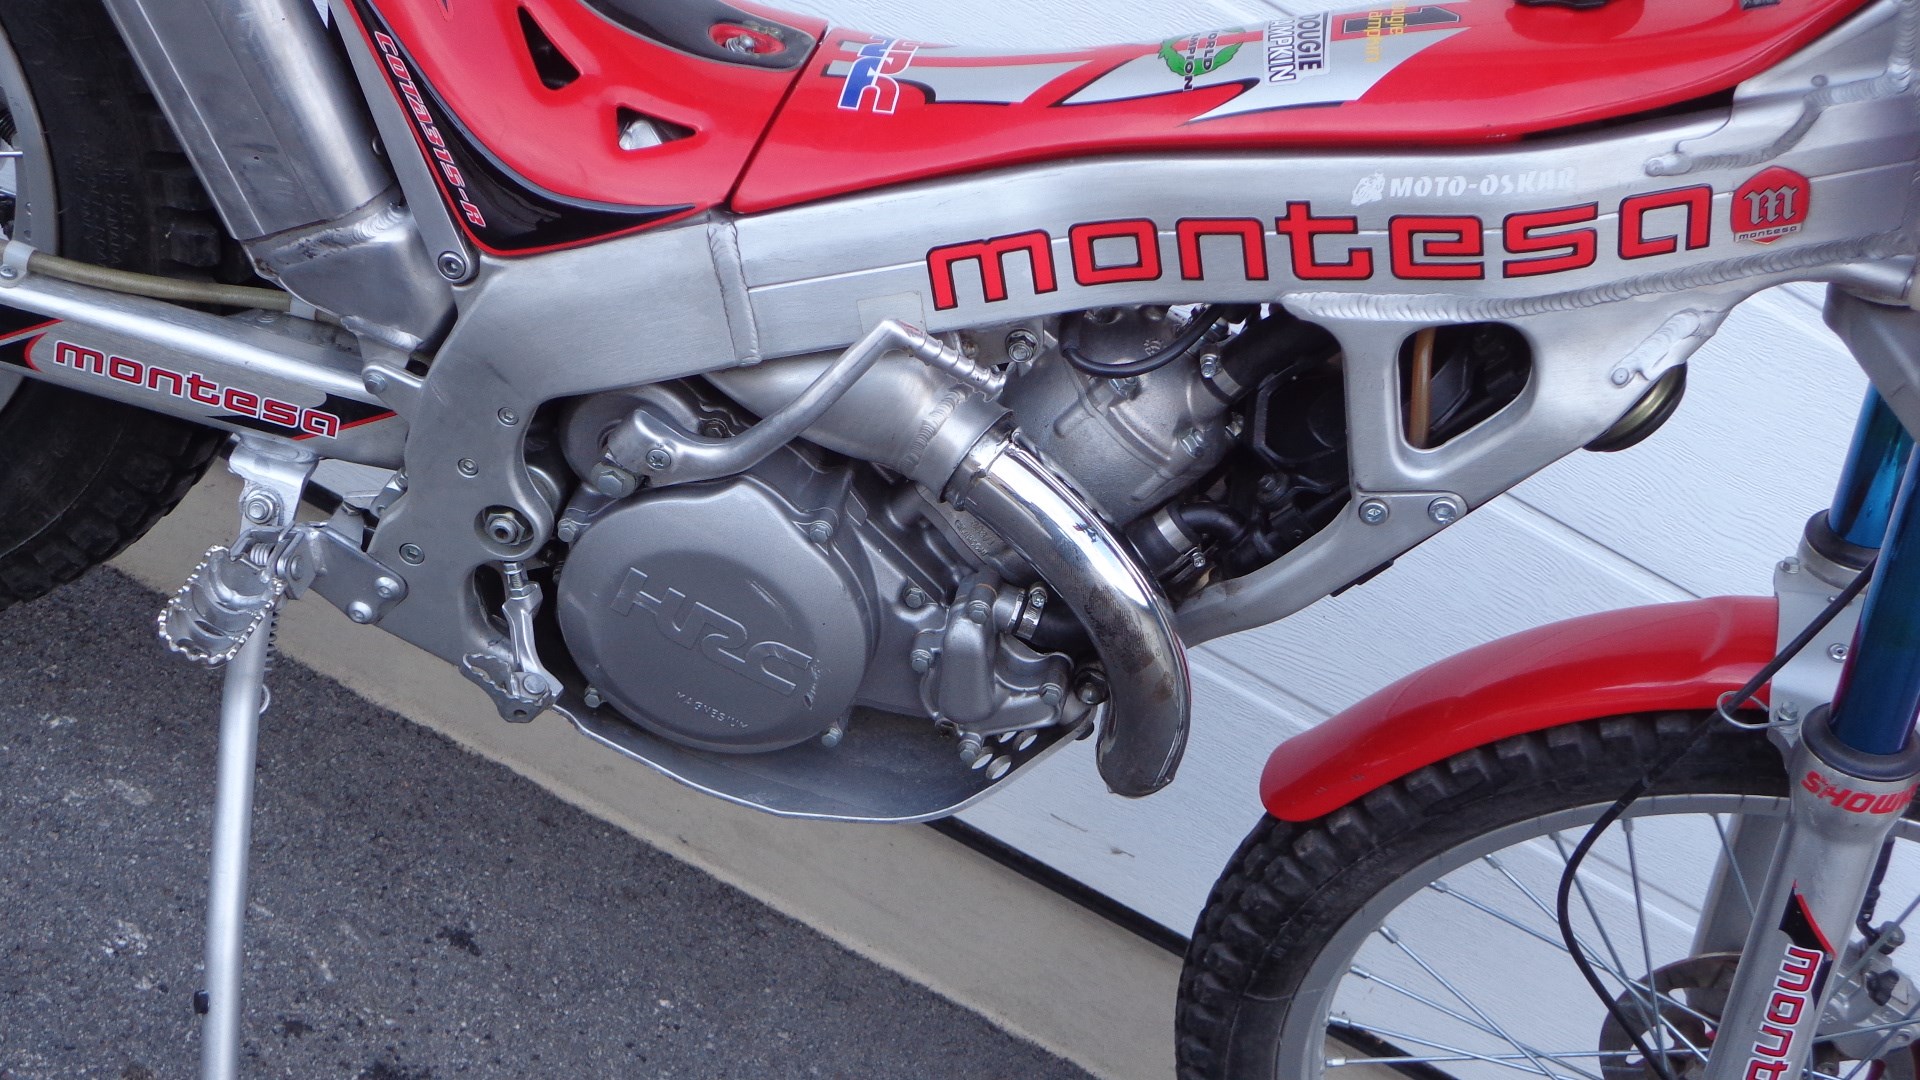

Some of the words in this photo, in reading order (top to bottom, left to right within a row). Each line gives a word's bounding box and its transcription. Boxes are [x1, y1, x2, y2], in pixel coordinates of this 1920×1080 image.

[1203, 31, 1218, 70] ORLD
[1267, 19, 1296, 83] AMPKIN
[1363, 10, 1383, 63] ampkin
[1390, 167, 1577, 197] MOTO-OSKAR
[926, 183, 1713, 311] montesa
[1738, 225, 1798, 240] montesa
[53, 340, 341, 439] montesa
[610, 567, 813, 697] HRC
